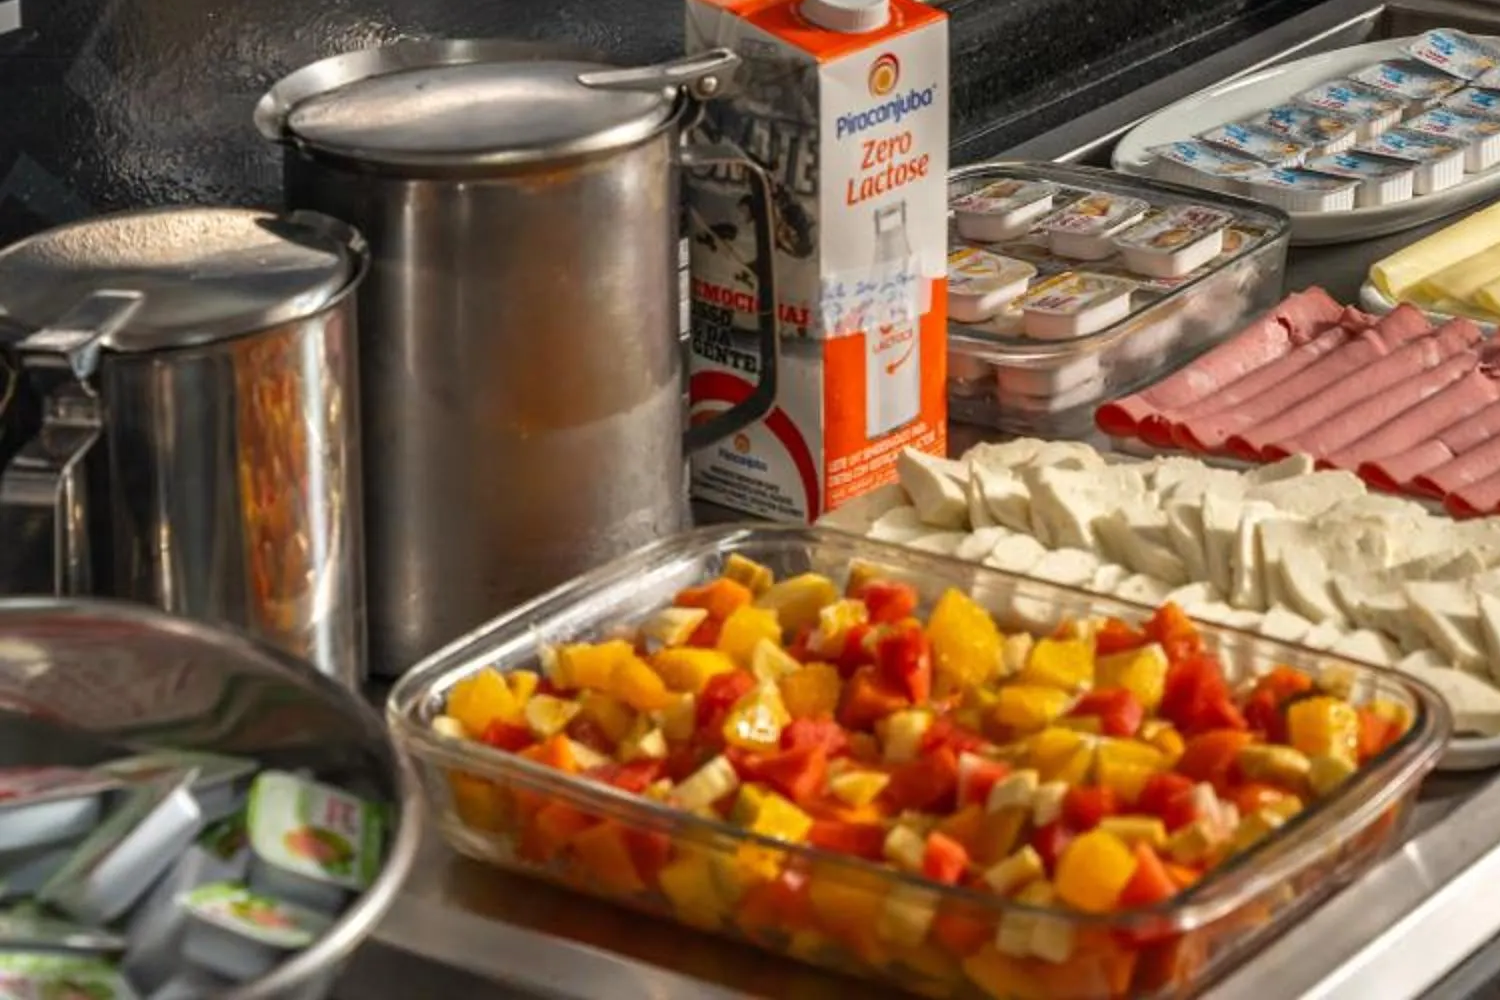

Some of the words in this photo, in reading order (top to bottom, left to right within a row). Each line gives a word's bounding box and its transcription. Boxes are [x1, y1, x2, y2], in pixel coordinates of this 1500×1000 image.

[837, 88, 932, 139] Piracanjuba
[862, 131, 912, 170] Zero
[847, 154, 929, 205] Lactose
